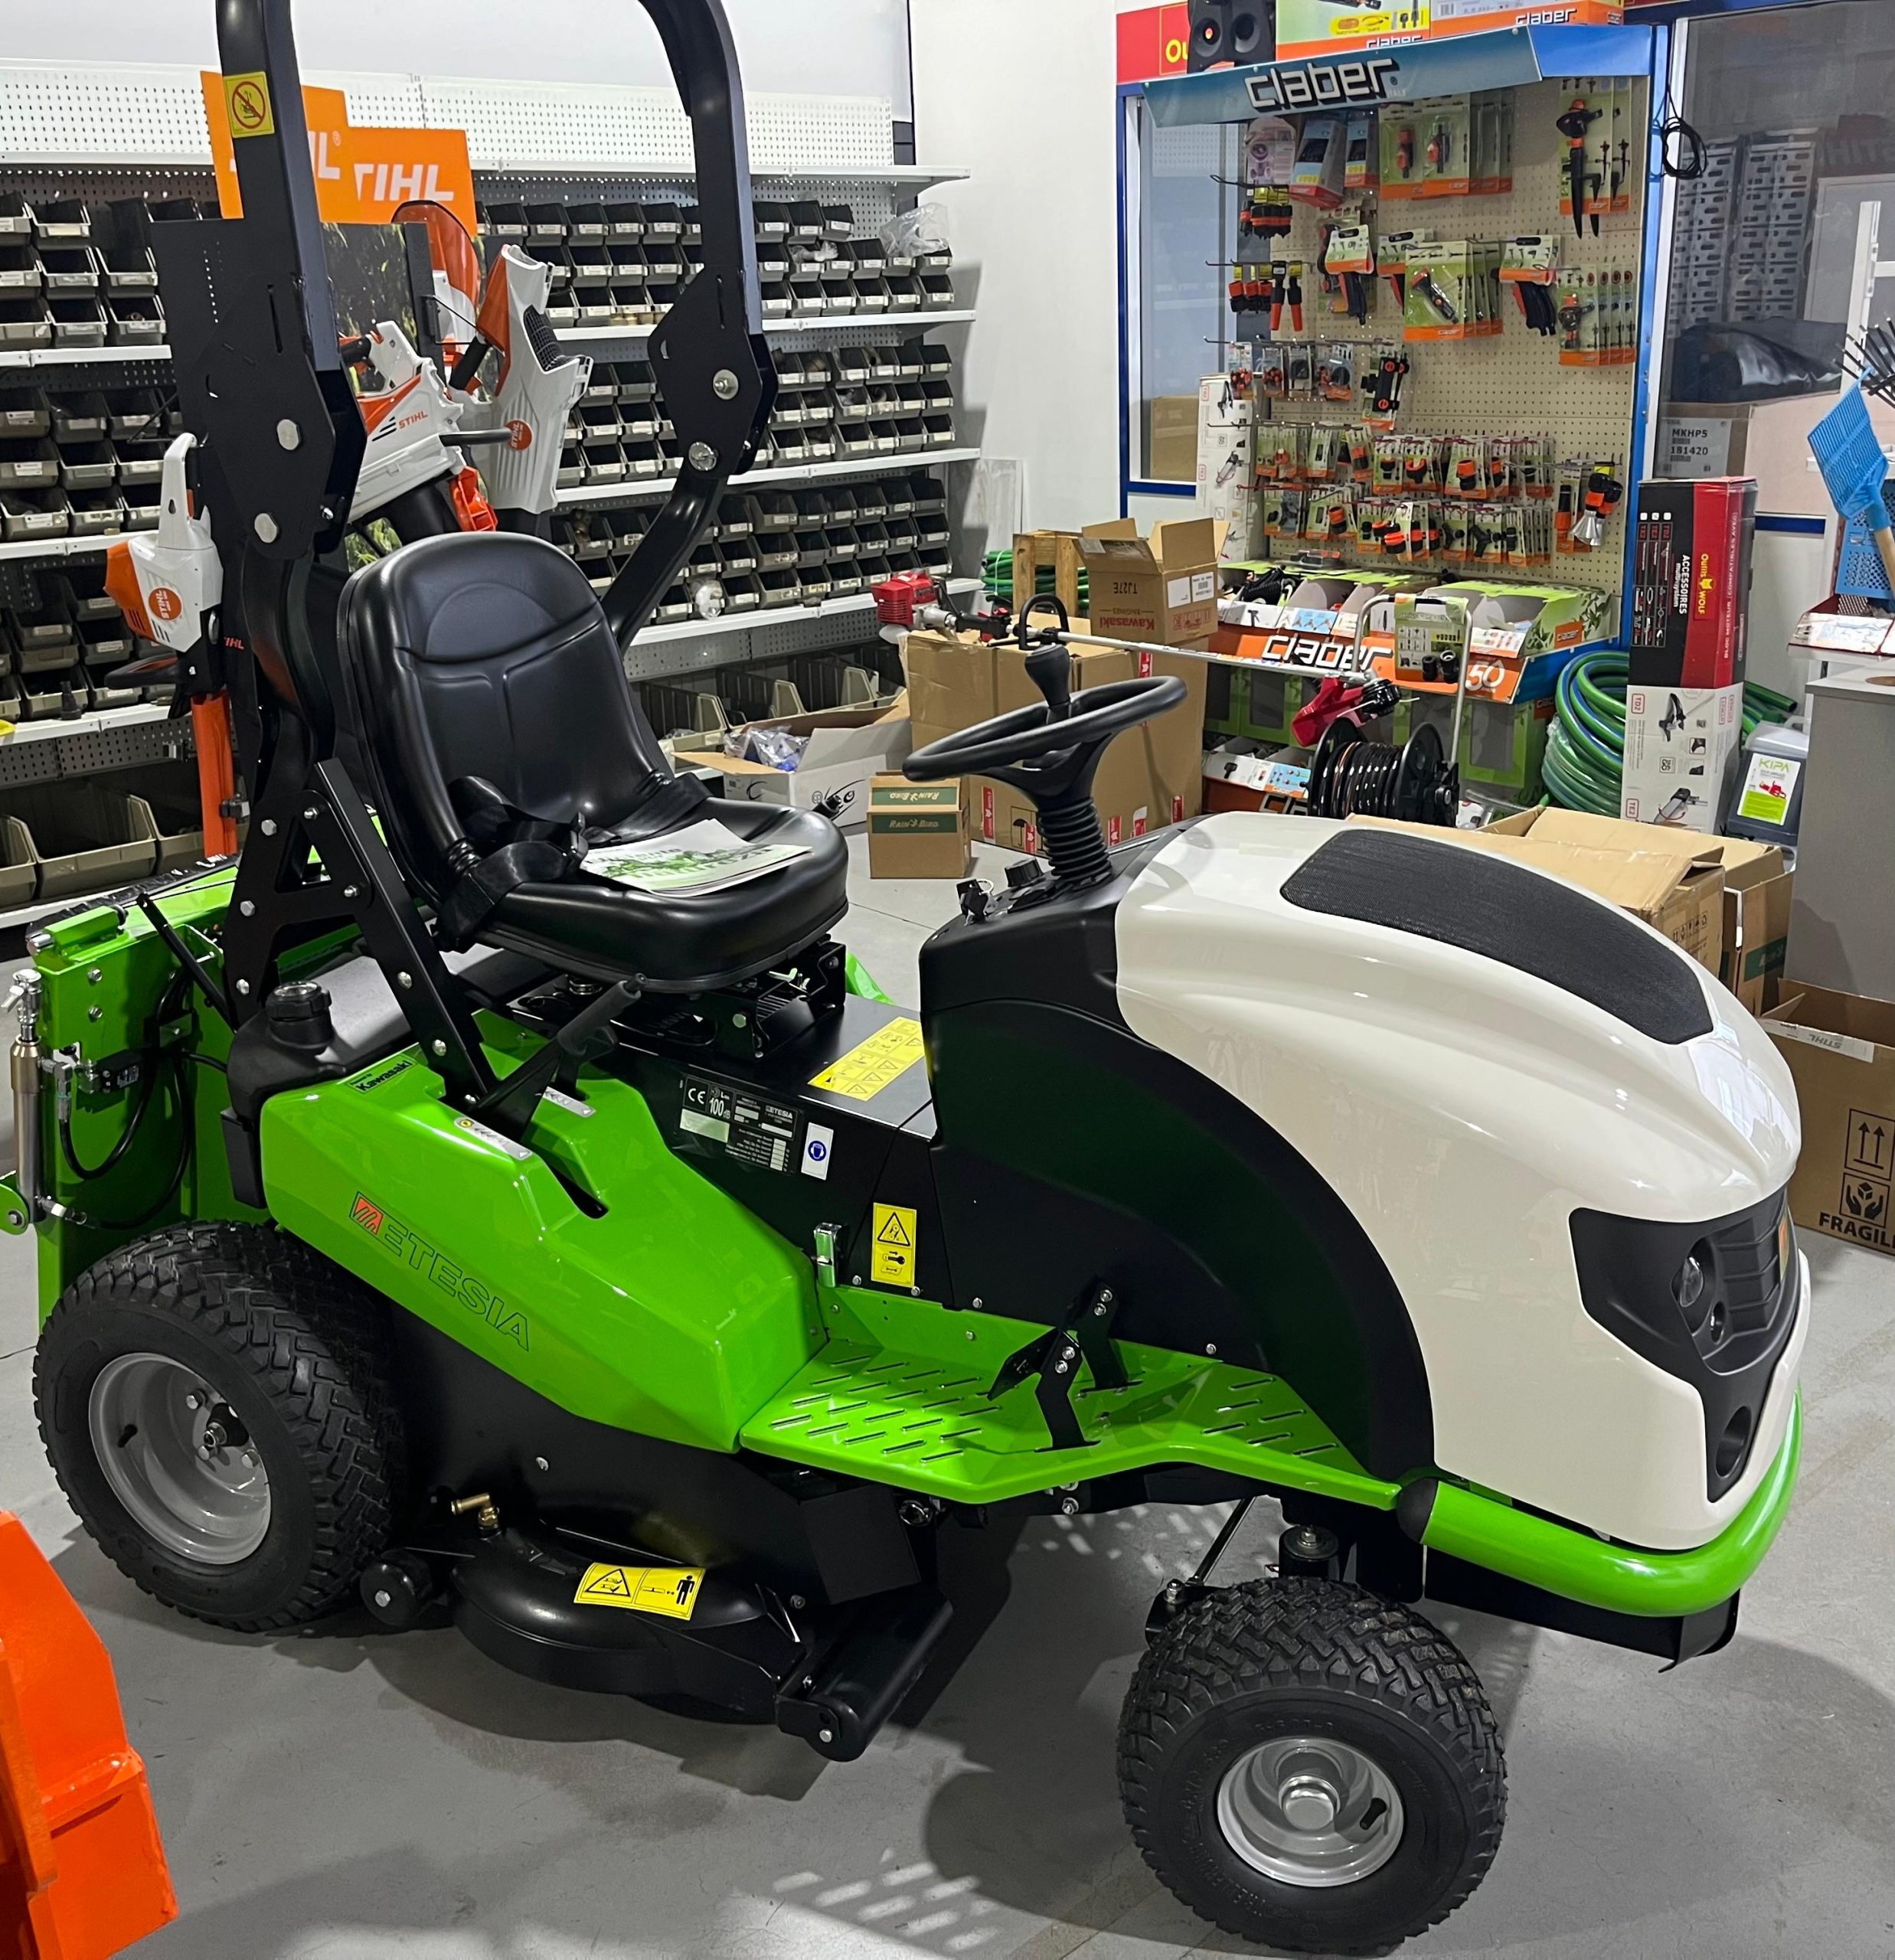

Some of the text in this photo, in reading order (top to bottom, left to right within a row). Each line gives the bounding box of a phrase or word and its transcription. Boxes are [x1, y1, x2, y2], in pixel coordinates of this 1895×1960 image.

[1515, 8, 1577, 26] claber
[1244, 58, 1397, 109] claber
[354, 163, 455, 201] TIHL
[398, 410, 429, 430] STIHL
[511, 422, 520, 448] STIHL
[1671, 429, 1708, 438] MKHP5
[1671, 446, 1708, 456] 181420
[1113, 582, 1138, 594] TJ27E
[1679, 554, 1691, 615] ACCESSOIRES
[1697, 553, 1709, 615] Outils WOLF
[155, 590, 168, 619] STIHL
[1099, 617, 1155, 630] Kawasaki
[890, 792, 939, 800] RAIN BIRD
[889, 820, 910, 828] RAIN
[1808, 1034, 1843, 1050] STIHL
[355, 1060, 413, 1091] Kawasaki
[709, 1097, 724, 1116] 100
[1818, 1211, 1895, 1249] FRAGIL
